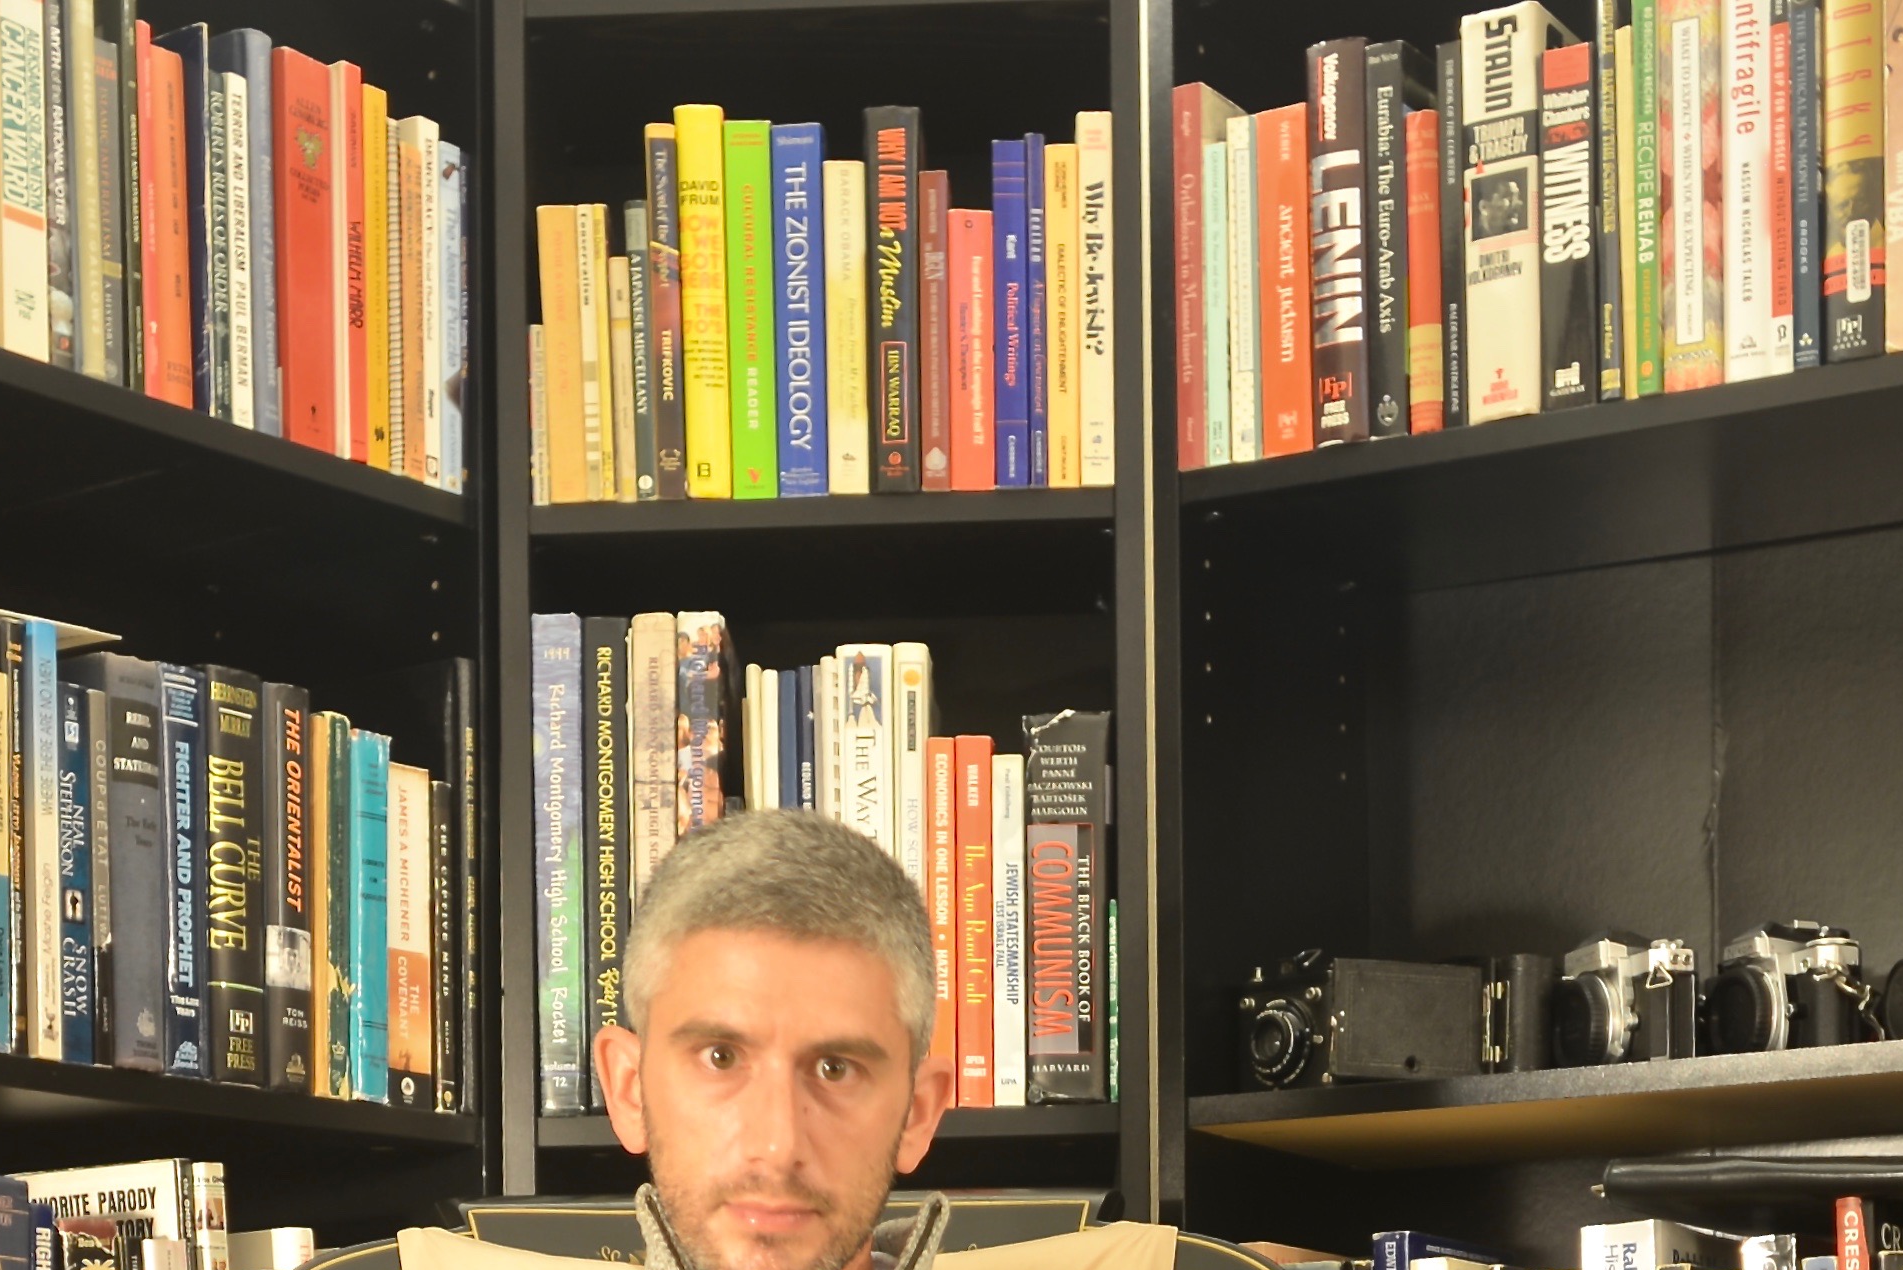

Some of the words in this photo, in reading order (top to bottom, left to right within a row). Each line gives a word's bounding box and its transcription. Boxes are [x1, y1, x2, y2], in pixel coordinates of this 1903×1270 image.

[0, 19, 26, 127] CANCER
[1485, 20, 1517, 113] STALIN
[232, 93, 242, 146] TERROR
[1377, 85, 1393, 156] Eurabia:
[5, 133, 27, 207] WARD
[233, 152, 242, 175] AND
[783, 162, 807, 209] THE
[1378, 161, 1392, 194] The
[234, 186, 245, 271] LIBERALISM
[1543, 141, 1590, 263] WITNESS
[784, 217, 809, 313] ZIONIST
[1311, 150, 1364, 348] LENIN
[1378, 200, 1393, 289] Euro-Arab
[236, 281, 245, 314] PAUL
[1378, 296, 1392, 334] Axis
[237, 325, 245, 387] BERMAN
[787, 320, 813, 450] IDEOLOGY
[598, 647, 611, 714] RICHARD
[286, 709, 299, 754] THE
[175, 741, 190, 832] FIGHTER
[210, 754, 243, 833] BELL
[598, 719, 615, 841] MONTGOMERY
[177, 834, 192, 883] AND
[287, 761, 302, 911] ORIENTALIST
[598, 846, 615, 887] HIGH
[210, 842, 246, 950] CURVE
[1077, 856, 1090, 888] THE
[177, 889, 194, 987] PROPHET
[599, 891, 616, 961] SCHOOL
[1032, 841, 1073, 1037] COMMUNISM
[1077, 894, 1090, 944] BLACK
[1077, 949, 1091, 995] BOOK
[1077, 1000, 1091, 1023] OF
[1032, 1062, 1090, 1073] HARVARD
